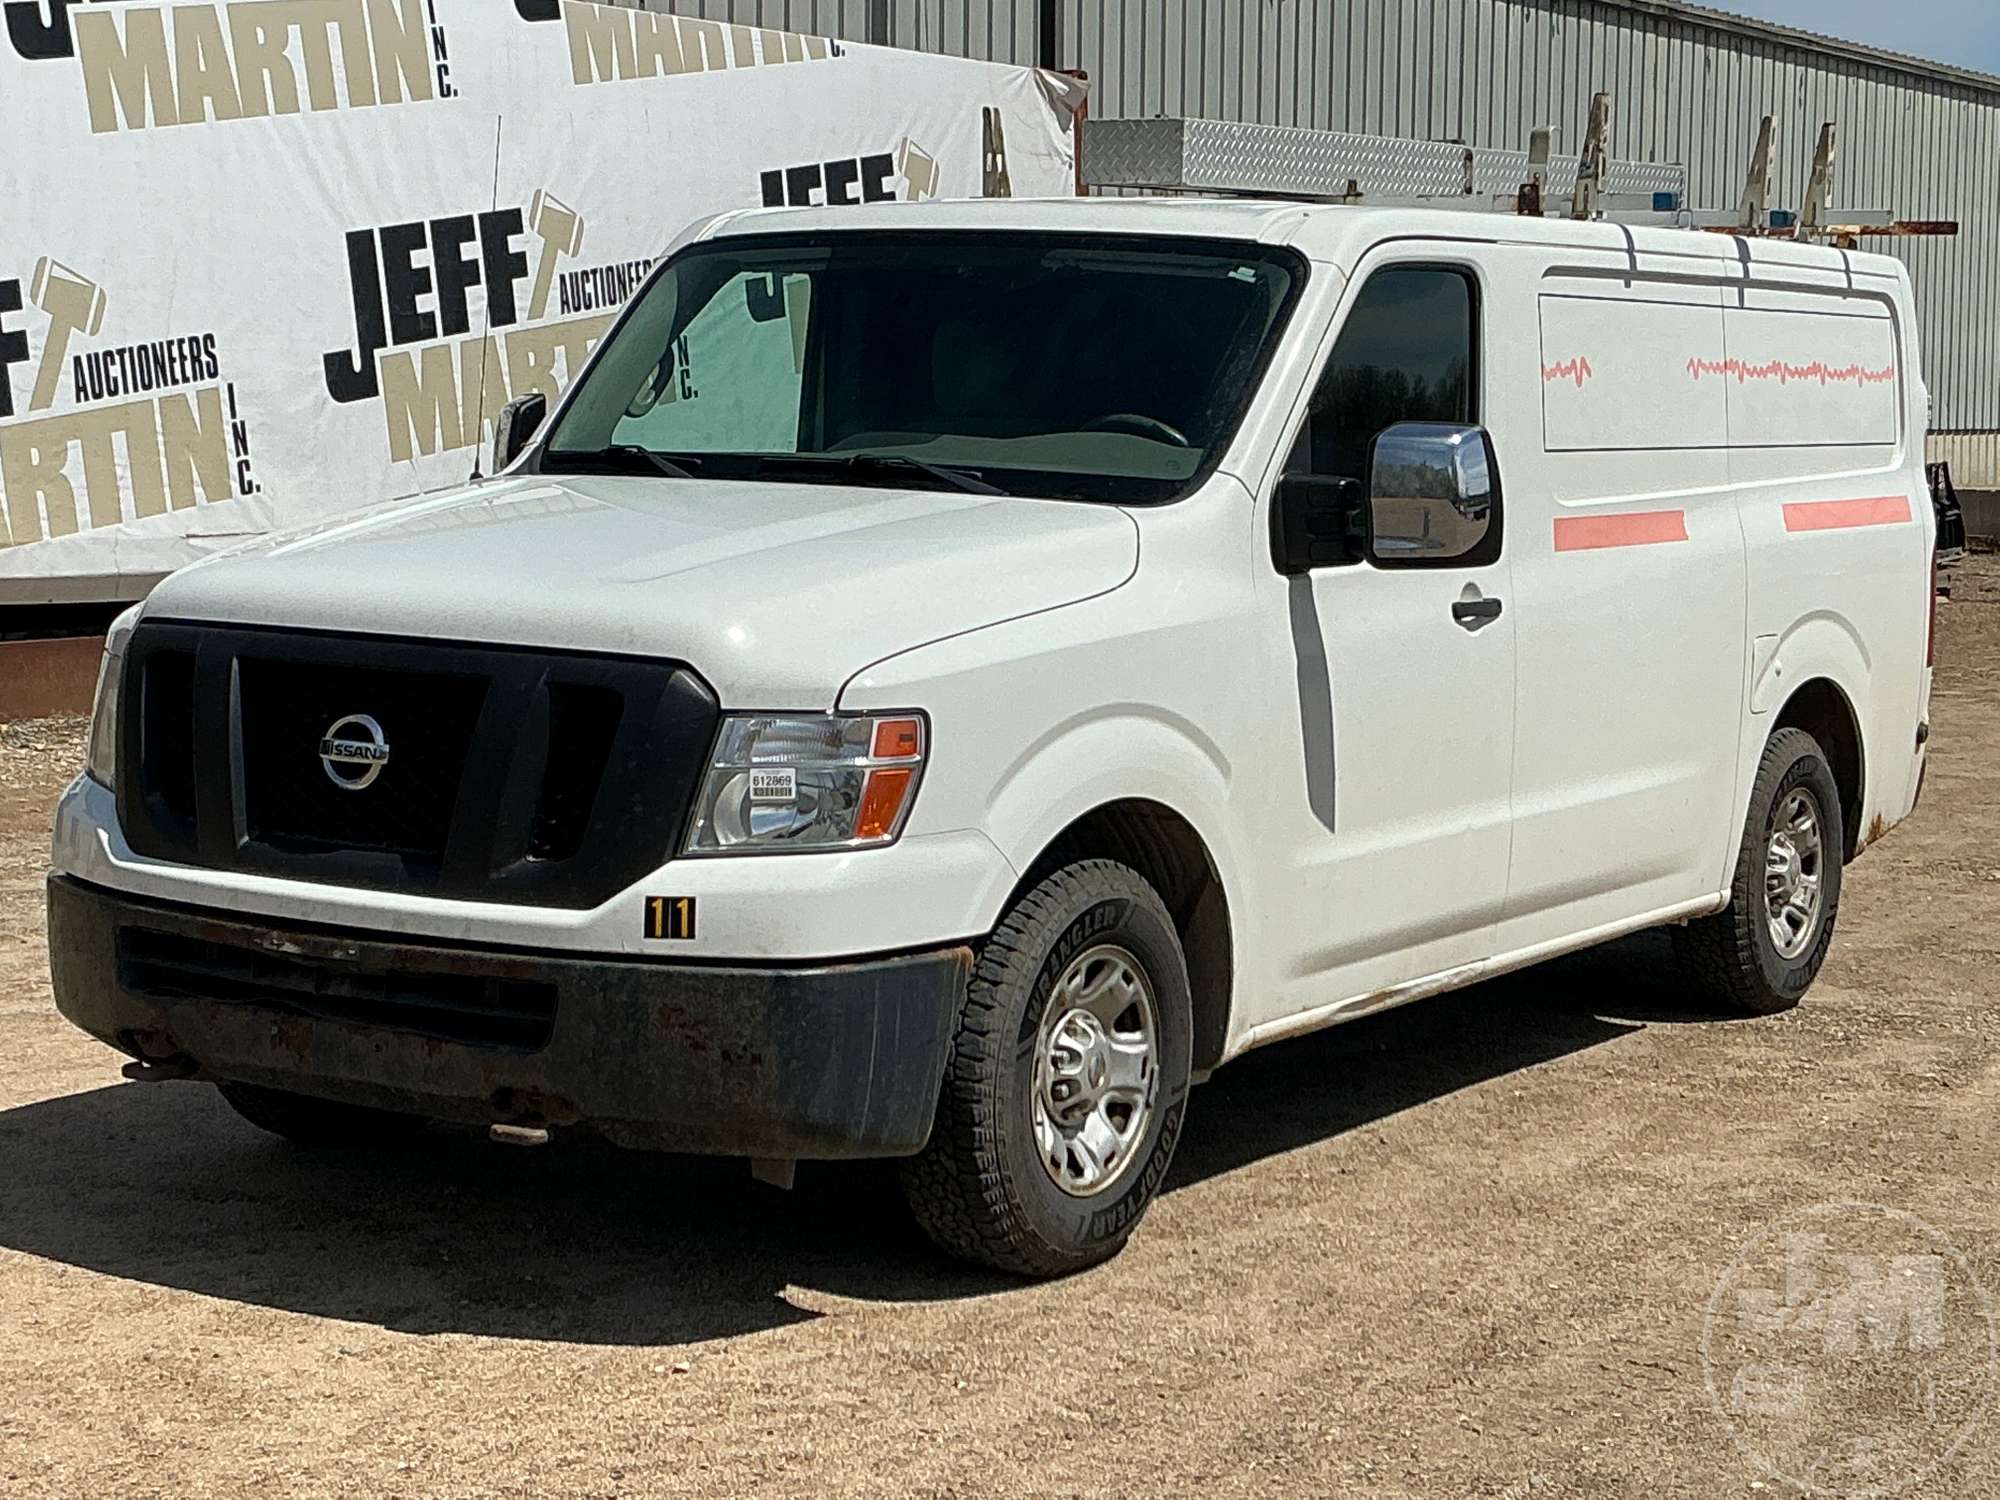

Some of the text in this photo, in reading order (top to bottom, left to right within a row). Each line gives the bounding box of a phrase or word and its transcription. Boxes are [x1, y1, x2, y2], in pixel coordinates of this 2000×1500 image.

[74, 0, 433, 133] MARTIN
[323, 207, 529, 403] JEFF
[73, 333, 219, 403] AUCTIONEERS
[0, 387, 233, 548] RTIN
[227, 382, 261, 496] INC.
[752, 775, 792, 787] 612869
[1027, 904, 1117, 1022] WRANGLER
